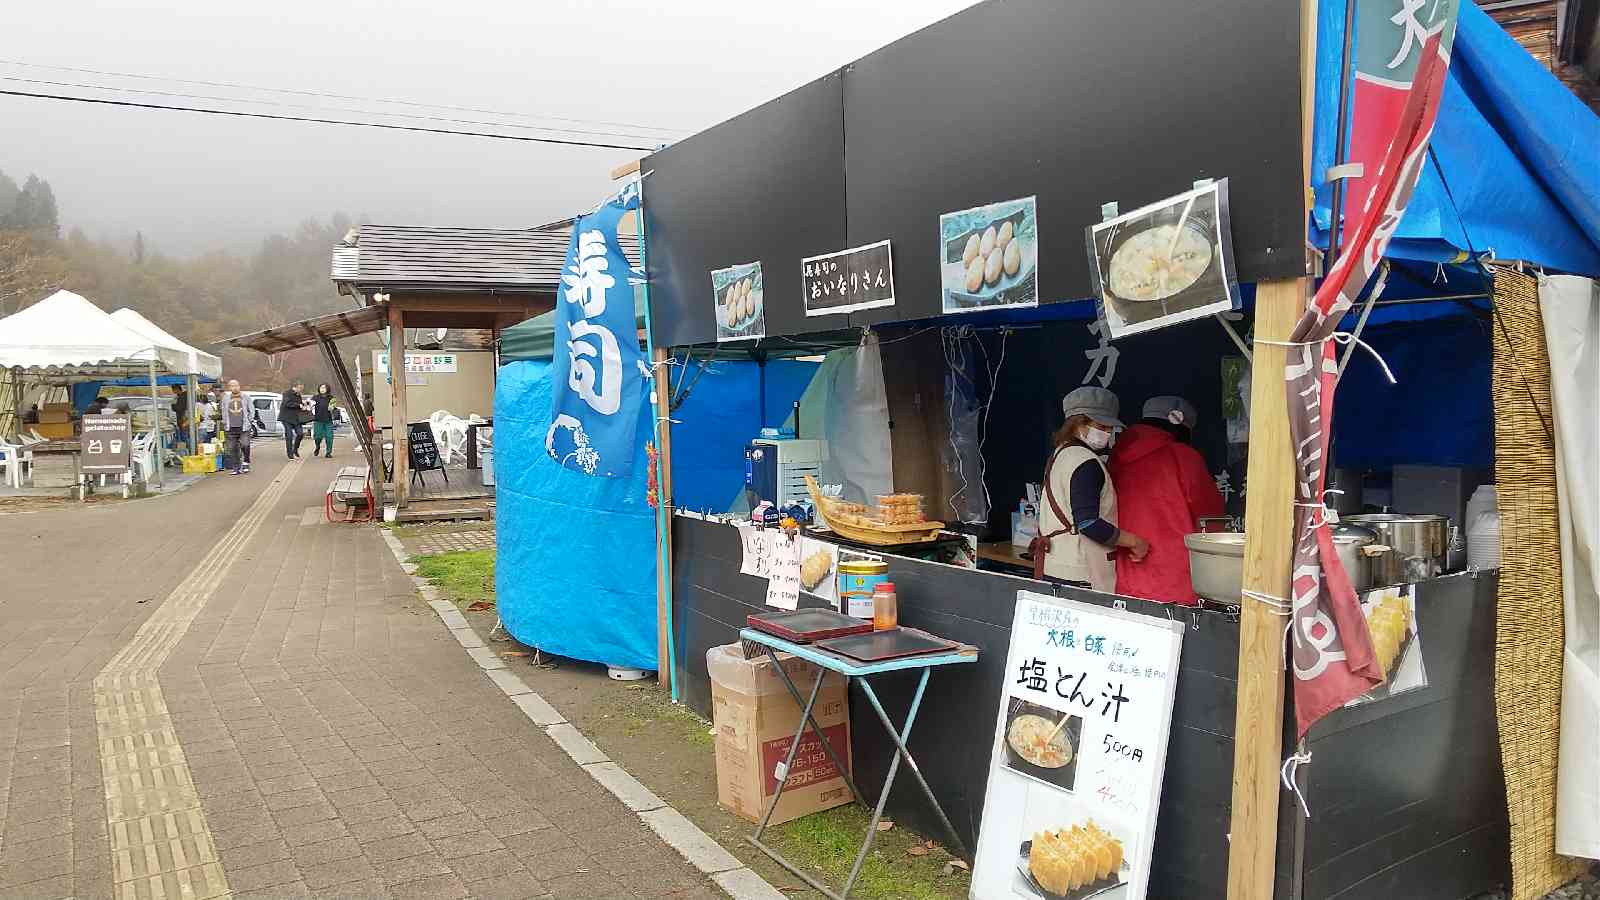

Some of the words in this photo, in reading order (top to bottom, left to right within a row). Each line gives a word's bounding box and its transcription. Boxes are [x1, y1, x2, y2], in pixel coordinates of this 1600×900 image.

[811, 268, 888, 300] おいなりさん
[560, 229, 623, 416] 寿司
[1017, 657, 1131, 723] 塩とん汁
[1103, 733, 1143, 763] 500円
